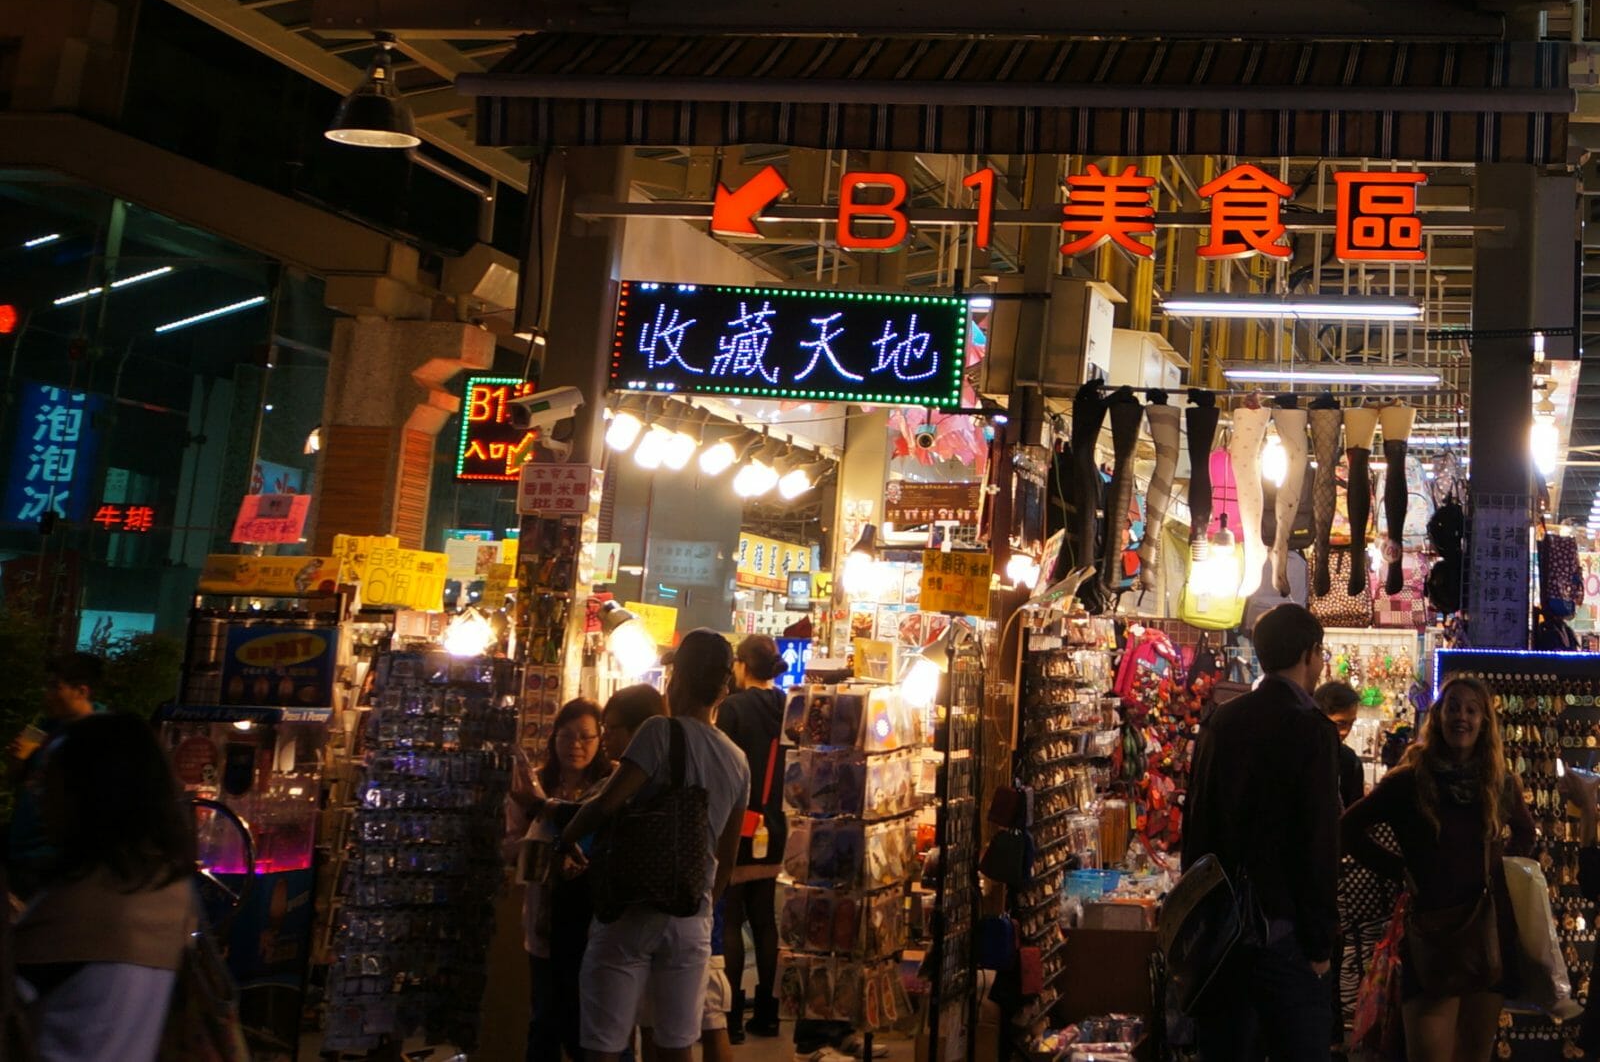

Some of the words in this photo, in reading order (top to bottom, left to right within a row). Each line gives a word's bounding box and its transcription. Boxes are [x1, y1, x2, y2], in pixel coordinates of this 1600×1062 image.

[637, 301, 940, 385] 收藏天地
[464, 439, 505, 461] 入口
[92, 504, 156, 533] 牛排
